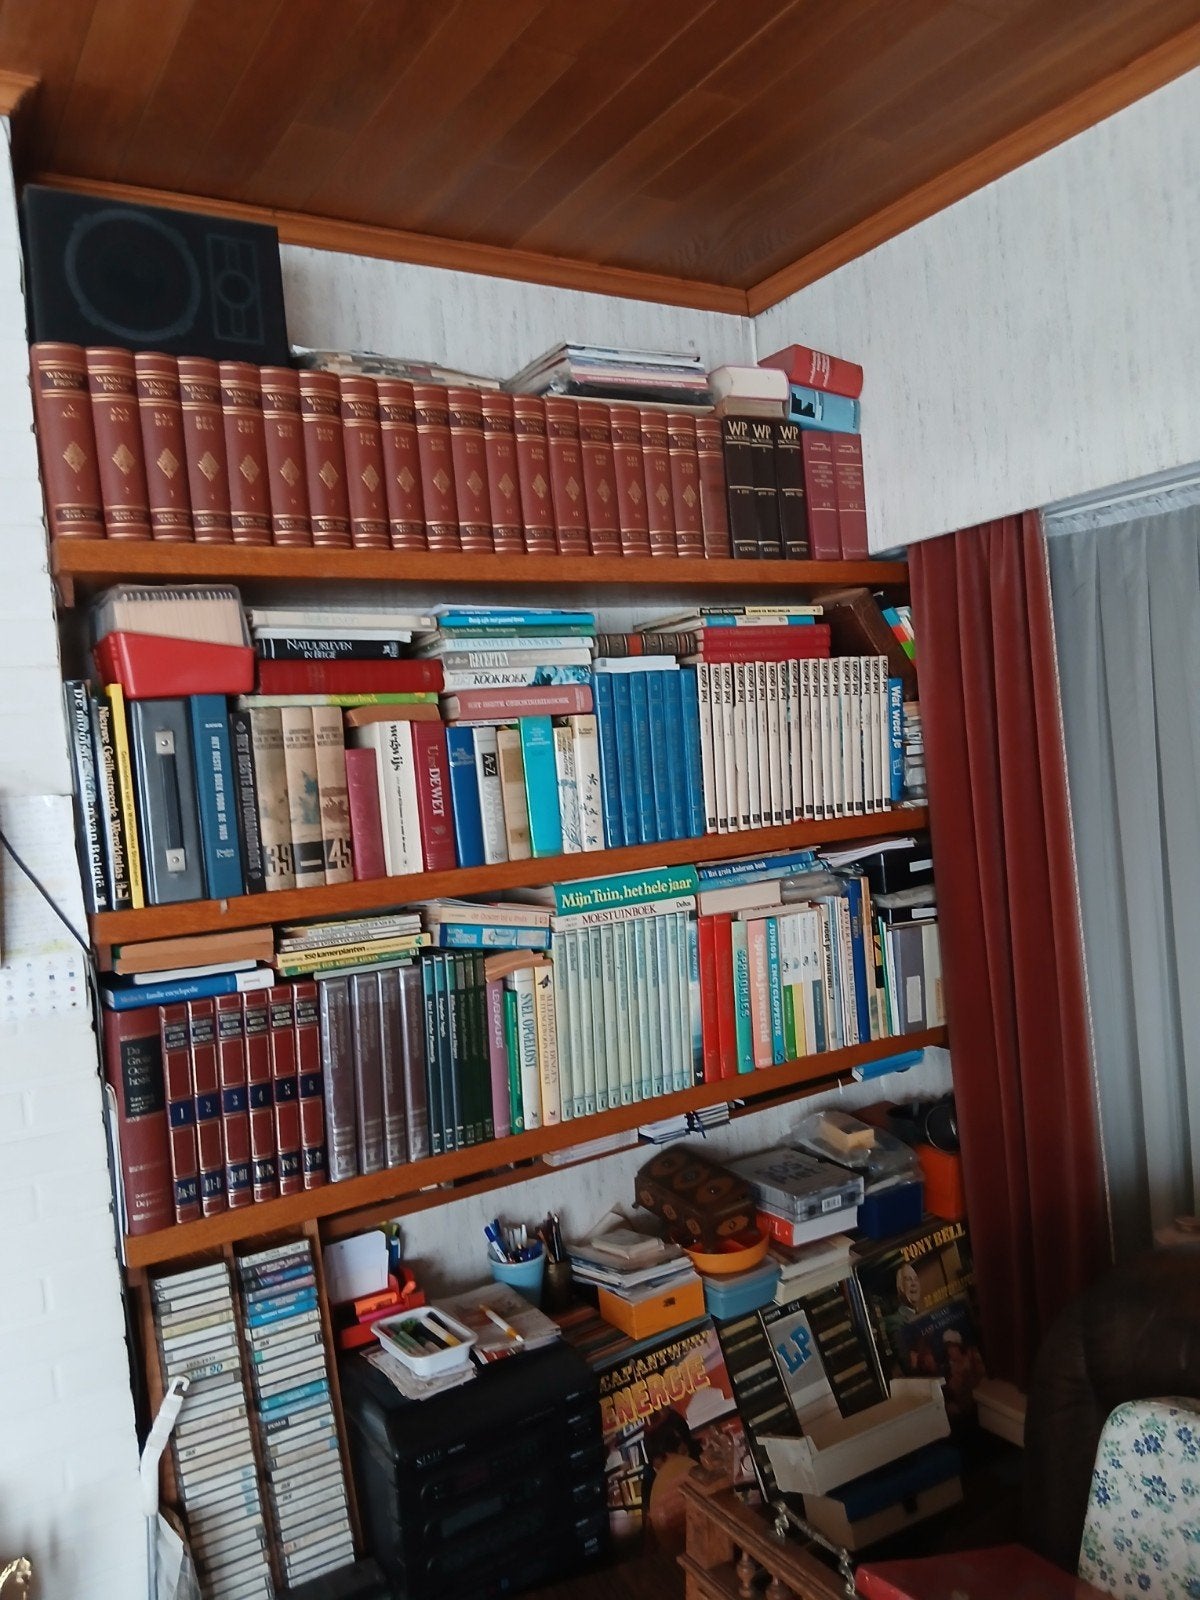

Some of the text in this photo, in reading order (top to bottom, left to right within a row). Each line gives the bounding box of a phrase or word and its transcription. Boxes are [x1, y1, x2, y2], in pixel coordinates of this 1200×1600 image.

[728, 420, 747, 436] WP
[752, 424, 771, 439] WP
[780, 426, 798, 440] WP
[474, 674, 527, 684] KOOKBOEK
[890, 686, 902, 749] Wat weet je
[390, 725, 404, 771] wegwijs
[98, 706, 112, 743] Nieuwe
[112, 821, 124, 880] Wereldatlas
[266, 838, 350, 877] 39 45
[561, 878, 692, 910] Mijn Tuin, het hele jaar
[582, 904, 657, 924] MOESTUINBOEK
[317, 946, 366, 960] kamerplanten
[768, 922, 778, 959] JUNIOR
[737, 950, 750, 1018] SPROOKJES
[754, 935, 770, 1042] Sprookjeswereld
[826, 954, 834, 988] waarom
[771, 964, 782, 1036] ENCYCLOPEDIE
[520, 993, 536, 1068] SNEL OPGELOST
[901, 1222, 966, 1262] TONY BELL
[776, 1325, 812, 1376] LP
[600, 1355, 711, 1434] ENERGIE
